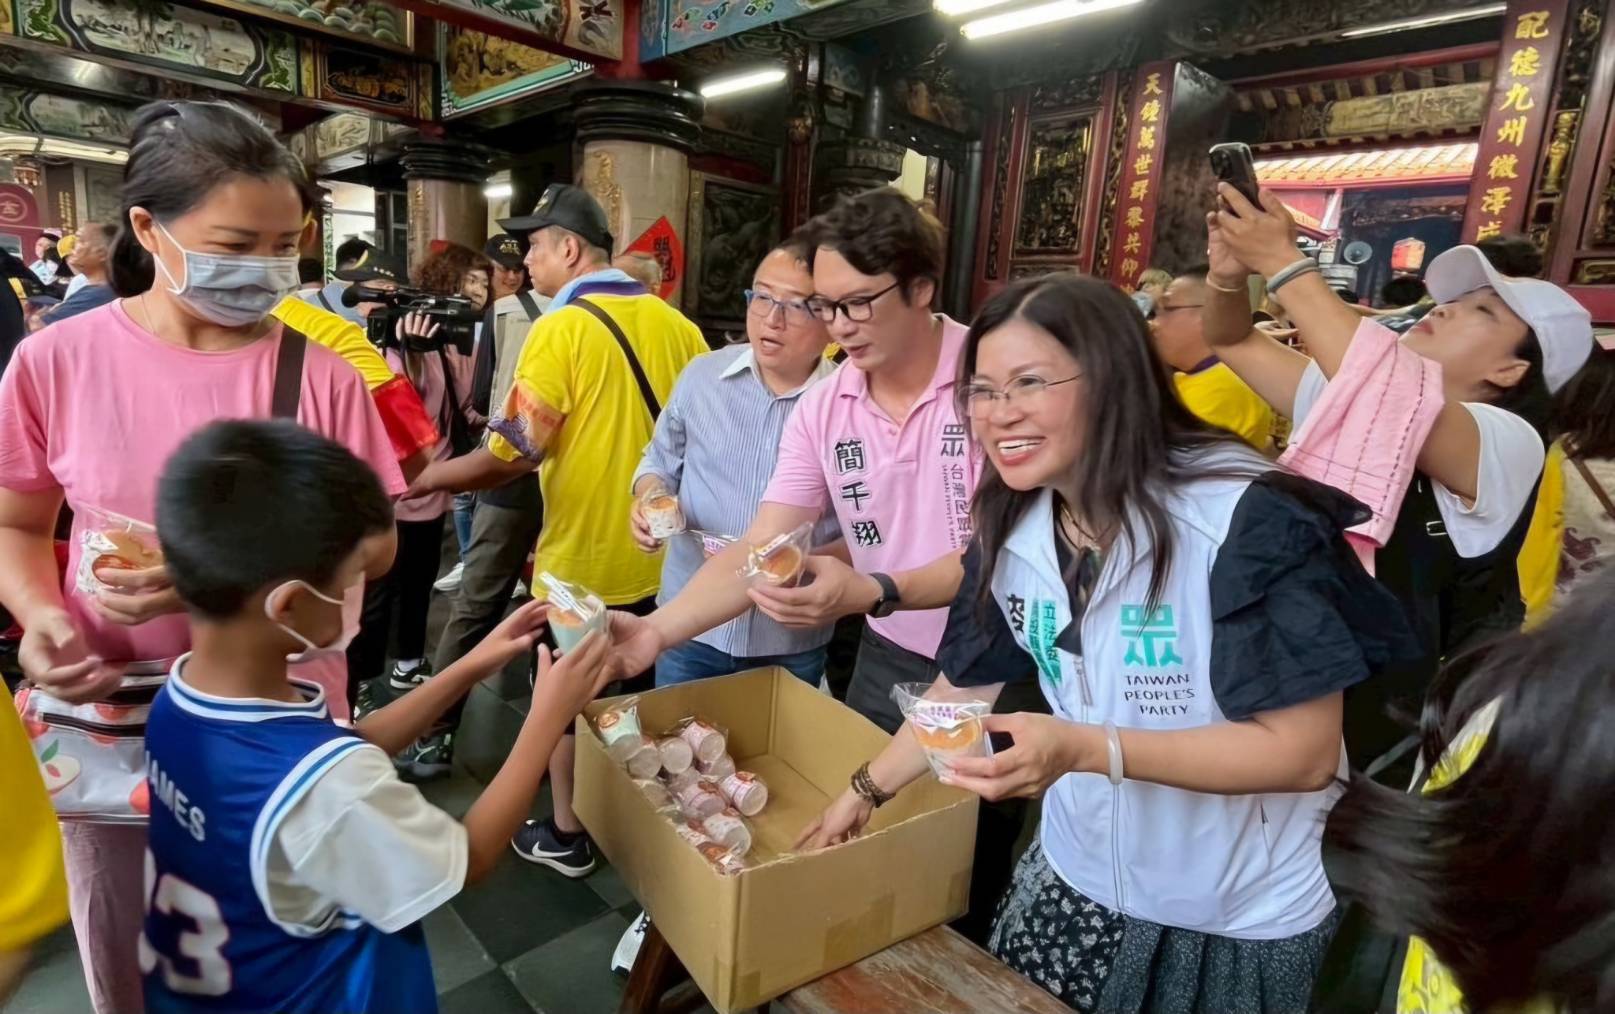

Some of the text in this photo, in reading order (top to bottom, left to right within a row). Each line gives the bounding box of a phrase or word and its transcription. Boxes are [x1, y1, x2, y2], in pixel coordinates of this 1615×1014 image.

[834, 439, 882, 546] 簡千翔
[1125, 674, 1190, 686] TAIWAN
[1124, 688, 1196, 701] PEOPLE'S
[1140, 704, 1189, 716] PARTY
